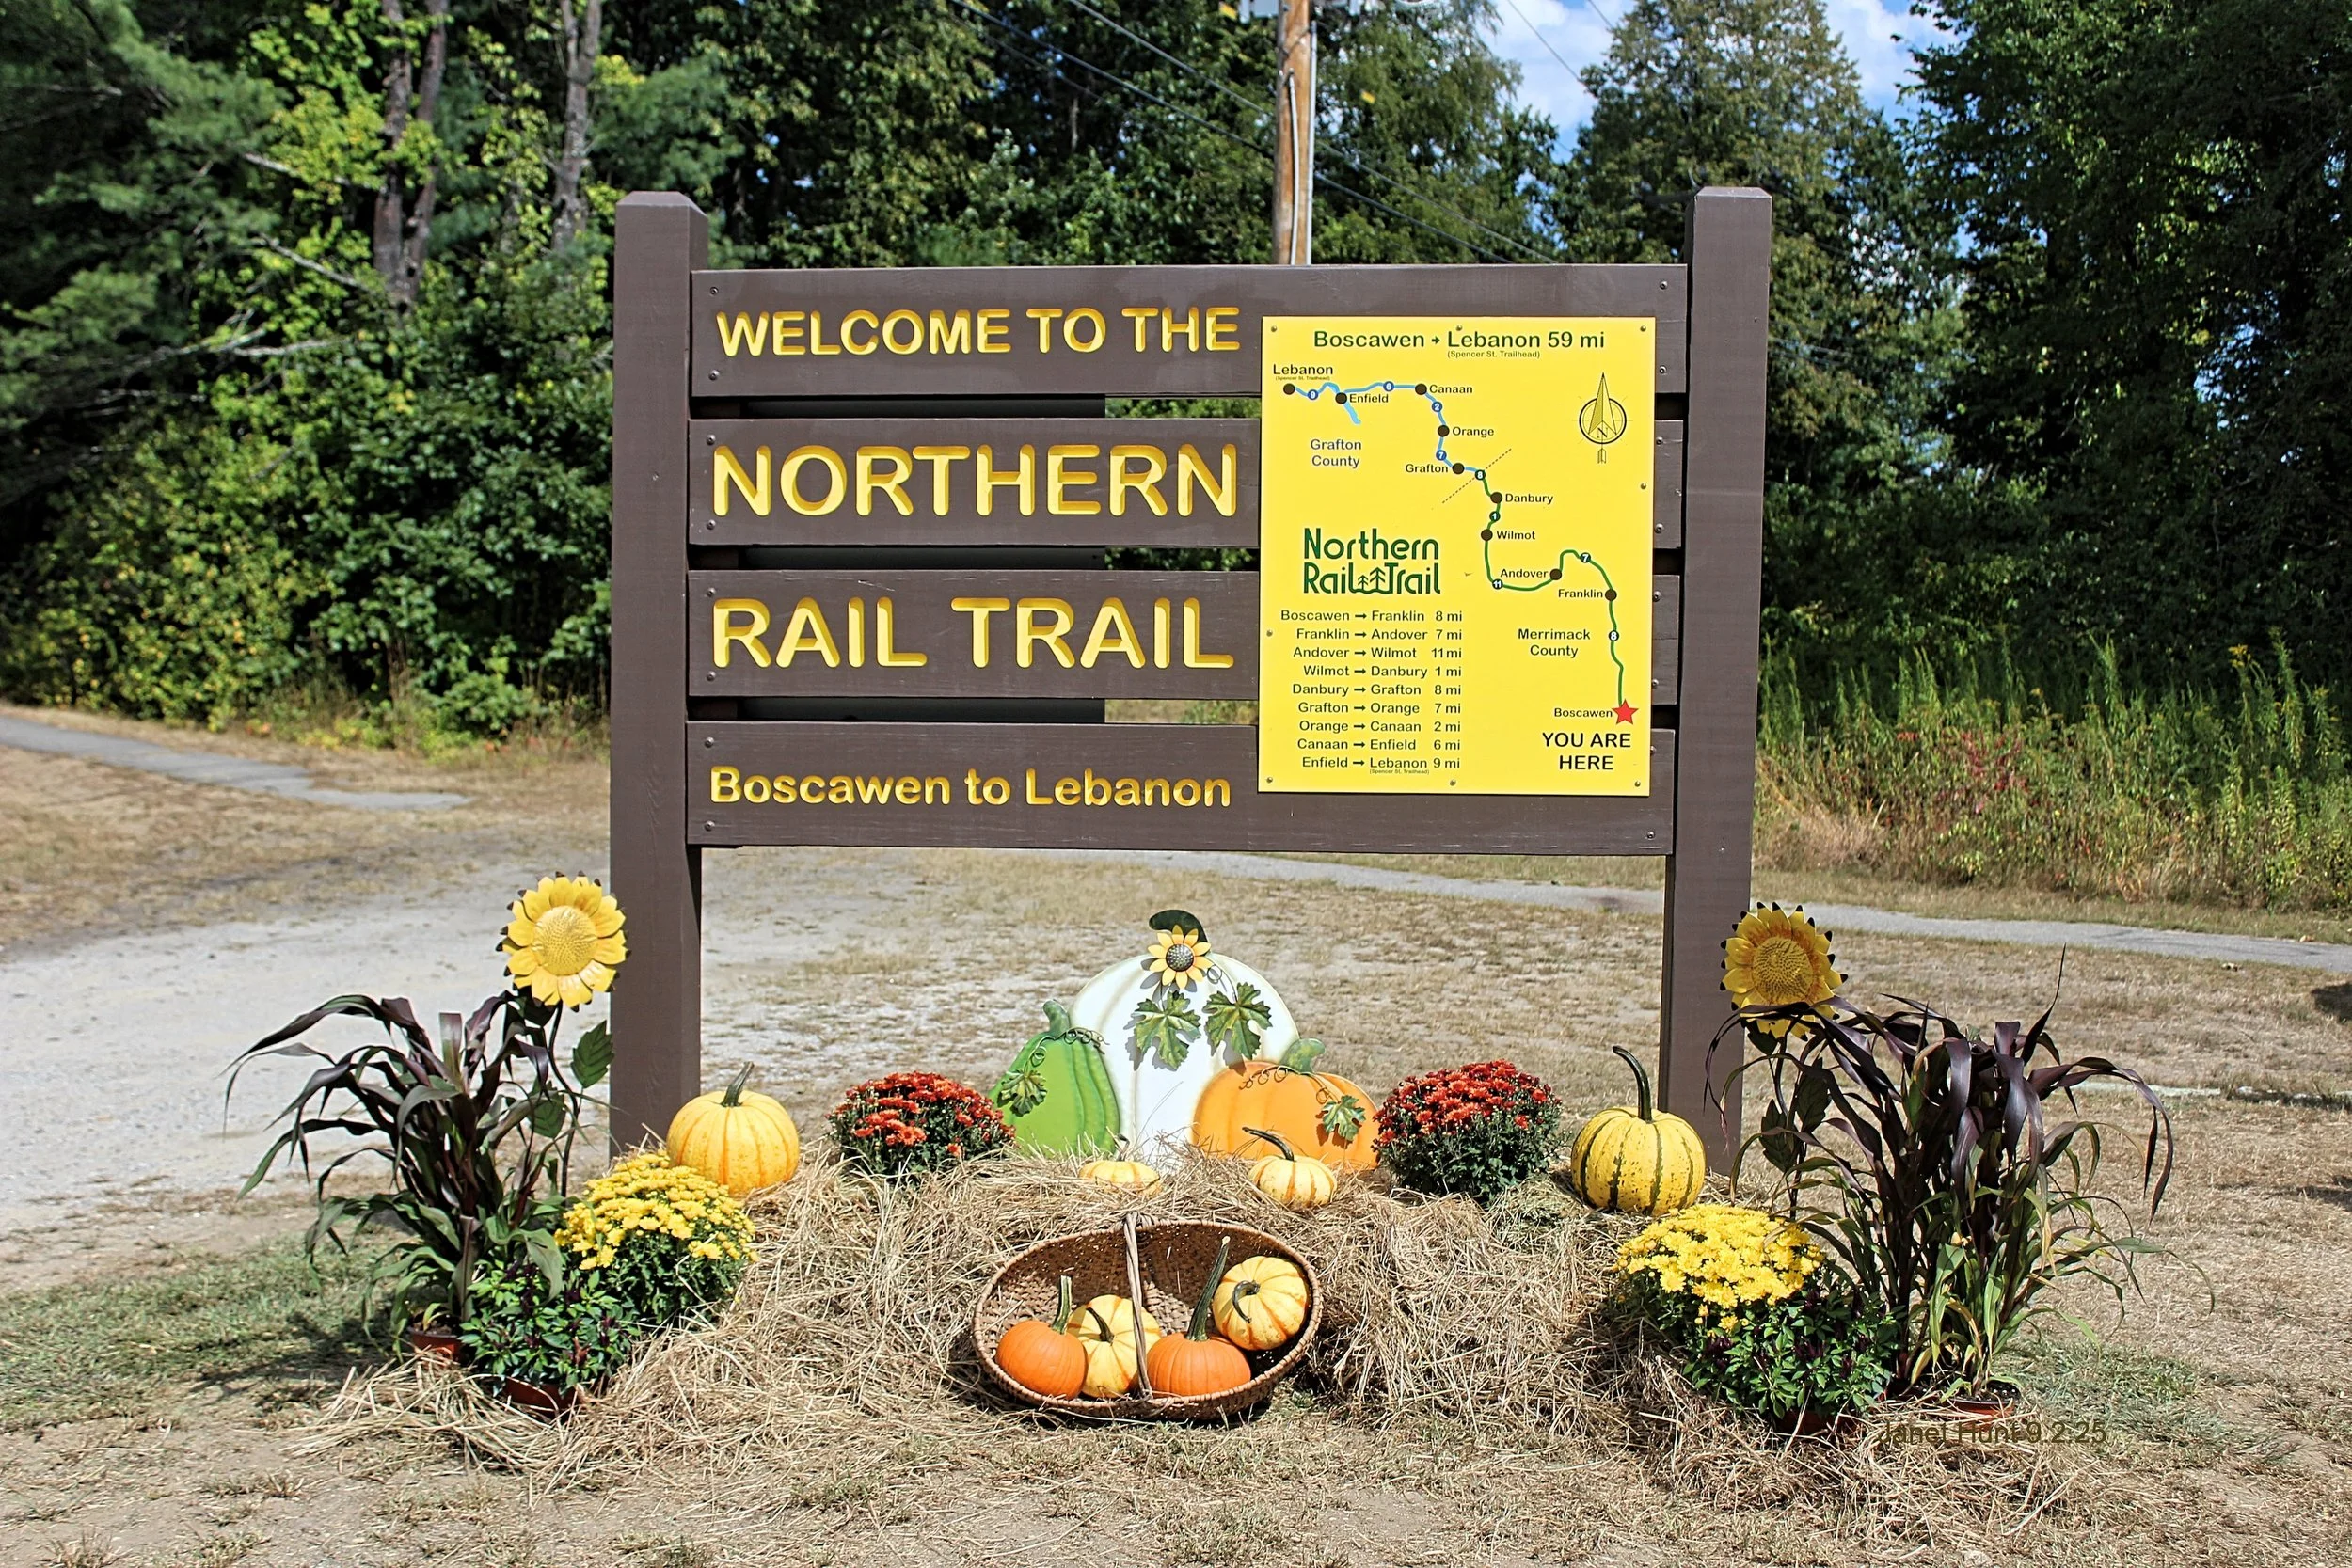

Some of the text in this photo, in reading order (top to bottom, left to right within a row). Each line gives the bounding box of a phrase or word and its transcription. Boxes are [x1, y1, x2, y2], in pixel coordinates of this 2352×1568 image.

[716, 307, 1240, 356] WELCOME TO THE
[1314, 330, 1603, 348] Boscawen Lebanon 59 mi
[1274, 364, 1333, 374] Lebanon
[1428, 385, 1472, 395] Canaan
[1350, 394, 1388, 403] Enfield
[1434, 403, 1440, 411] 2
[1453, 427, 1494, 437] Orange
[1311, 439, 1361, 450] Grafton
[1312, 455, 1359, 468] County
[1406, 463, 1449, 472] Grafton
[713, 443, 1237, 515] NORTHERN
[1505, 494, 1553, 504] Danbury
[1497, 531, 1535, 539] Wilmot
[1305, 528, 1438, 560] Northern
[1501, 569, 1548, 578] Andover
[1559, 589, 1603, 597] Franklin
[1281, 610, 1462, 621] Boscawen Franklin 8 mi
[713, 597, 1234, 668] RAIL TRAIL
[1297, 628, 1461, 640] Franklin Andover 7 mi
[1518, 628, 1590, 640] Merrimack
[1294, 647, 1461, 657] Andover Wilmot 11 mi
[1531, 645, 1578, 658] County
[1304, 665, 1461, 679] Wilmot Danbury 1 mi
[1293, 684, 1460, 697] Danbury Grafton 8 mi
[1298, 702, 1460, 716] Grafton Orange 7 mi
[1554, 708, 1613, 717] Boscawen
[1299, 721, 1460, 734] Orange Canaan 2 mi
[1298, 738, 1460, 750] Canaan Enfield 6 mi
[1543, 733, 1630, 748] YOU ARE
[1303, 757, 1459, 768] Enfield Lebanon 9 mi
[1560, 755, 1613, 770] HERE
[710, 766, 1231, 806] Boscawen to Lebanon
